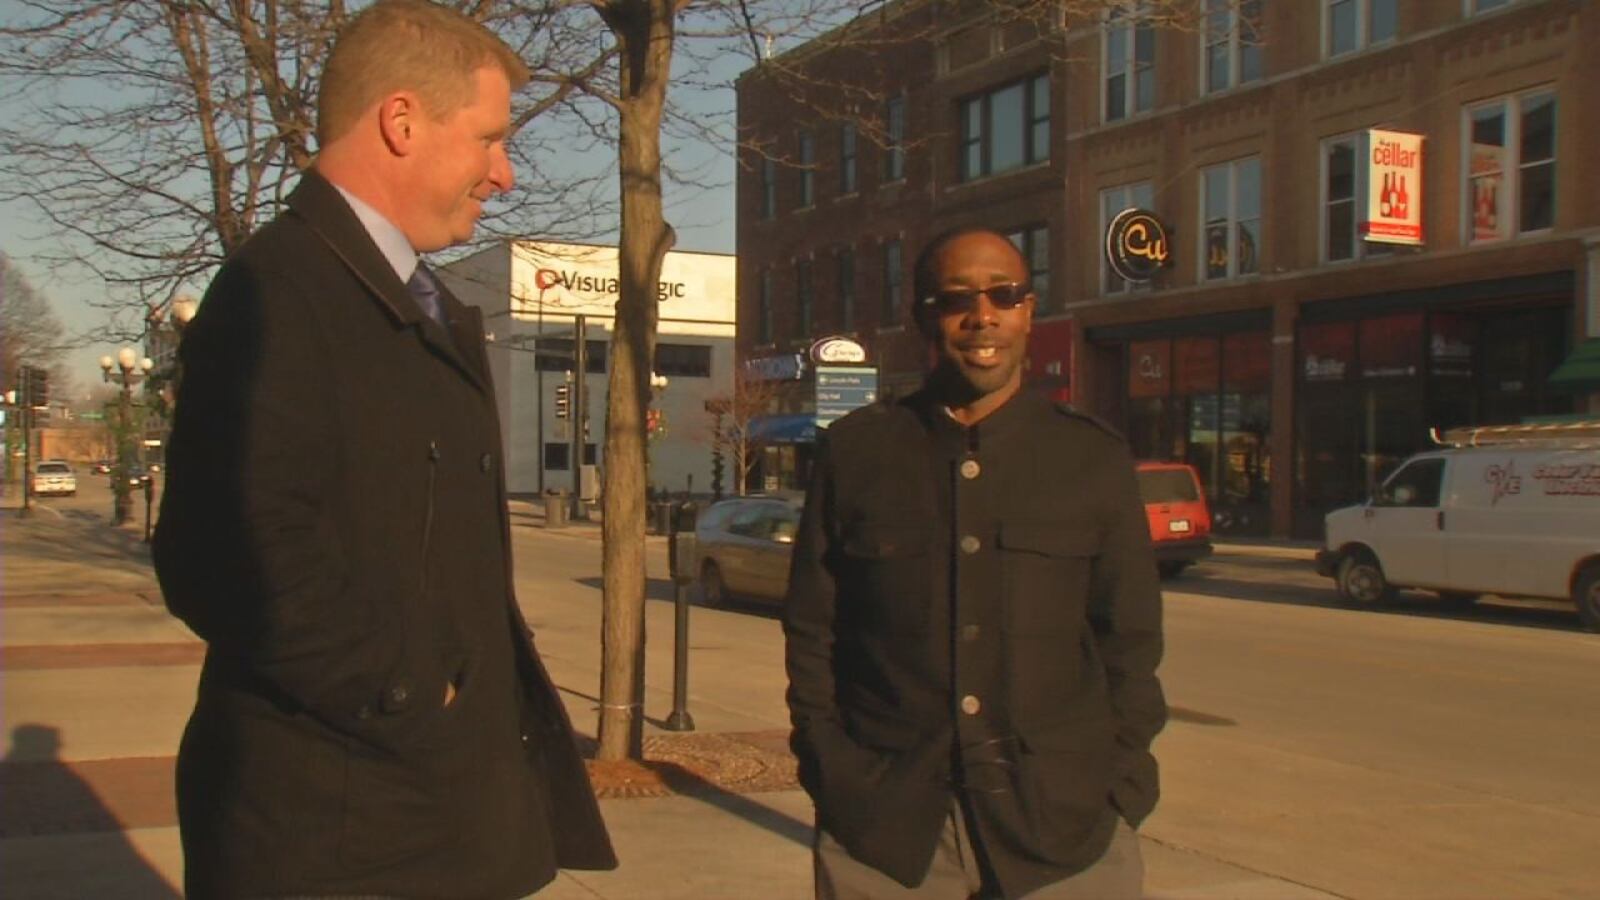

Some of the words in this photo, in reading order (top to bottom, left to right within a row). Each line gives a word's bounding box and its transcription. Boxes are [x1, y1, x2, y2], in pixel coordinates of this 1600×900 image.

[1373, 142, 1416, 168] cellar
[1124, 223, 1168, 261] Cu
[561, 270, 619, 294] Visua
